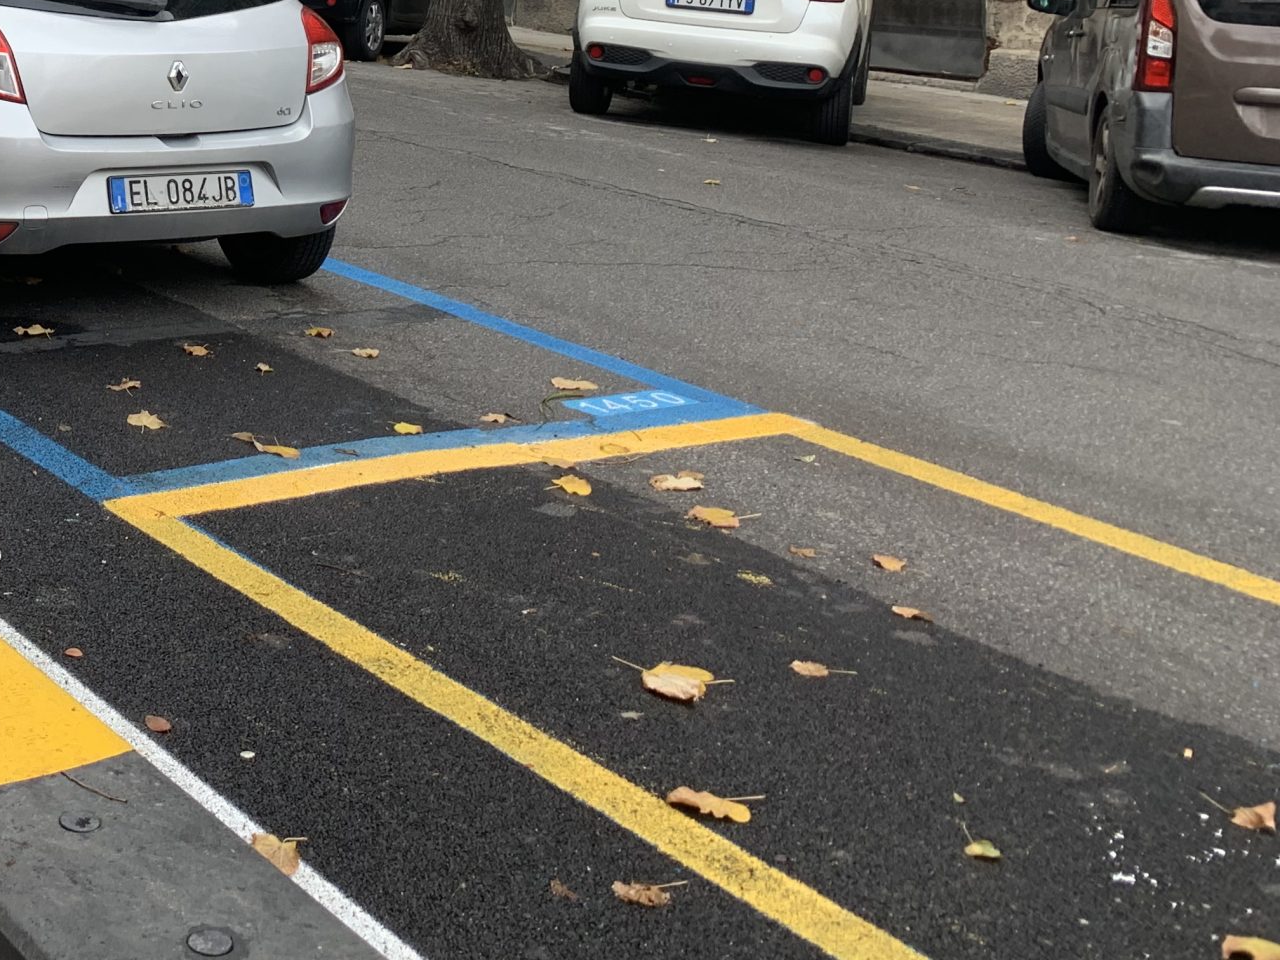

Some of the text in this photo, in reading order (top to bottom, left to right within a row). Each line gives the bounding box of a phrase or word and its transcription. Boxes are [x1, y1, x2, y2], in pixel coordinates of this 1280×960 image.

[151, 99, 203, 110] CLIO
[128, 175, 237, 207] EL 084JB
[579, 391, 686, 414] 1450
